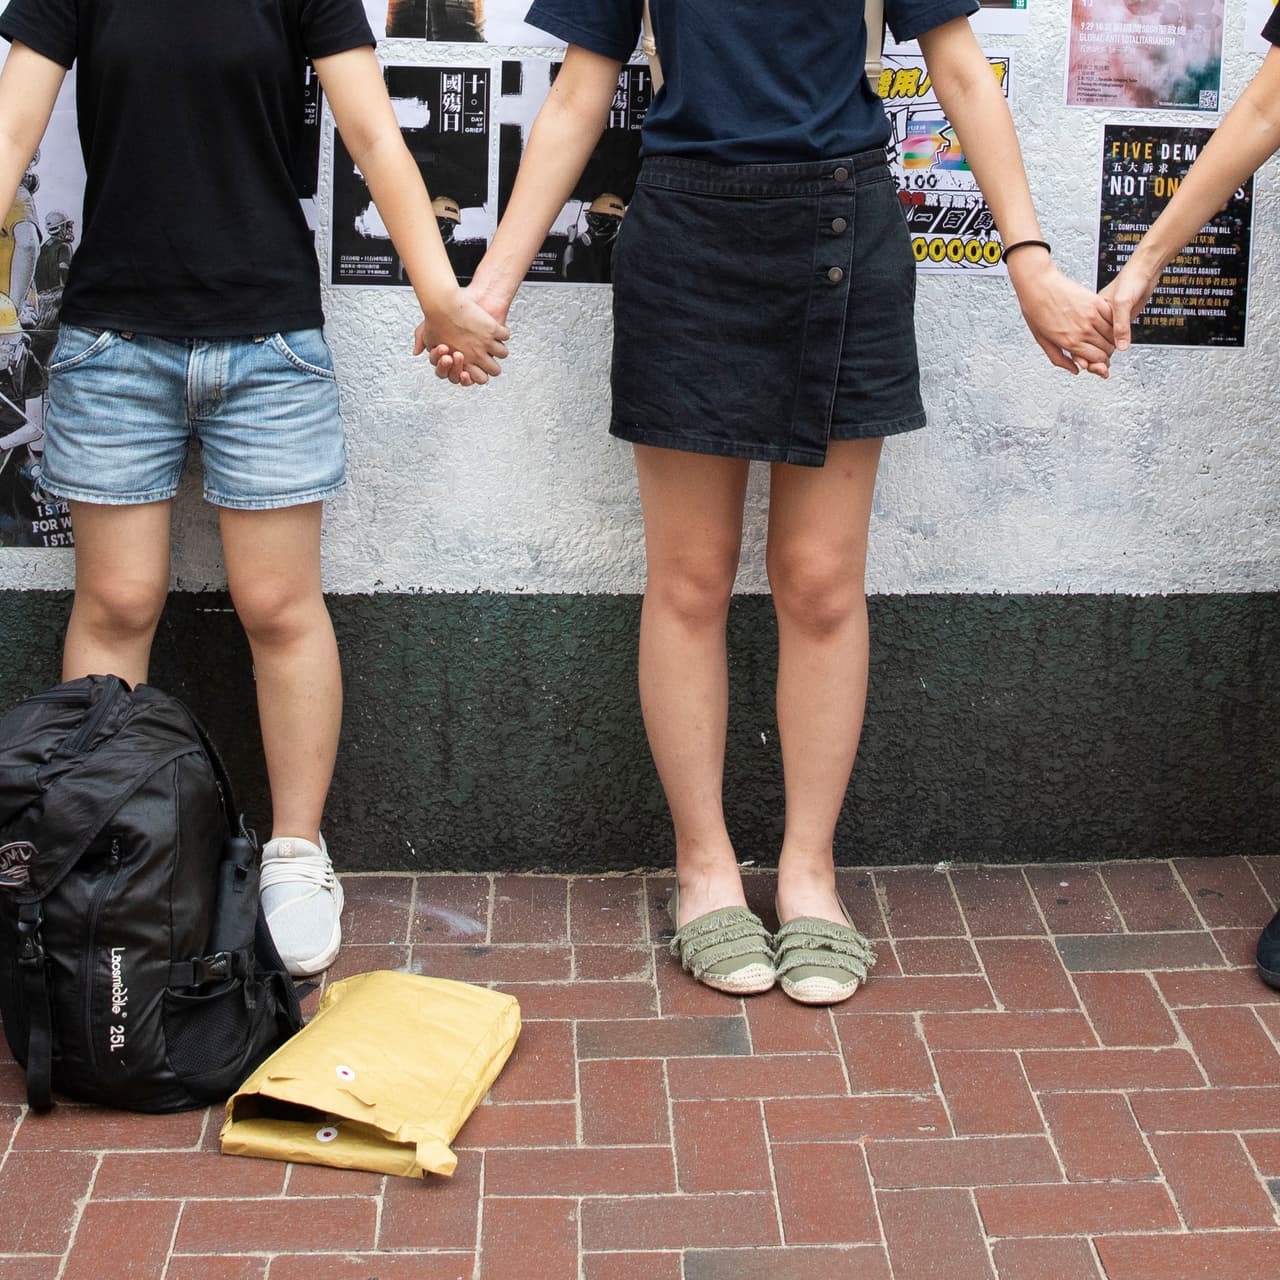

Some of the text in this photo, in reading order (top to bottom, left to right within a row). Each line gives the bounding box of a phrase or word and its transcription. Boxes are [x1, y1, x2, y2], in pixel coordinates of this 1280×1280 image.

[442, 73, 462, 132] 國殤日
[1111, 142, 1153, 160] FIVE
[1112, 162, 1169, 174] 五大訴求
[1109, 176, 1147, 196] NOT
